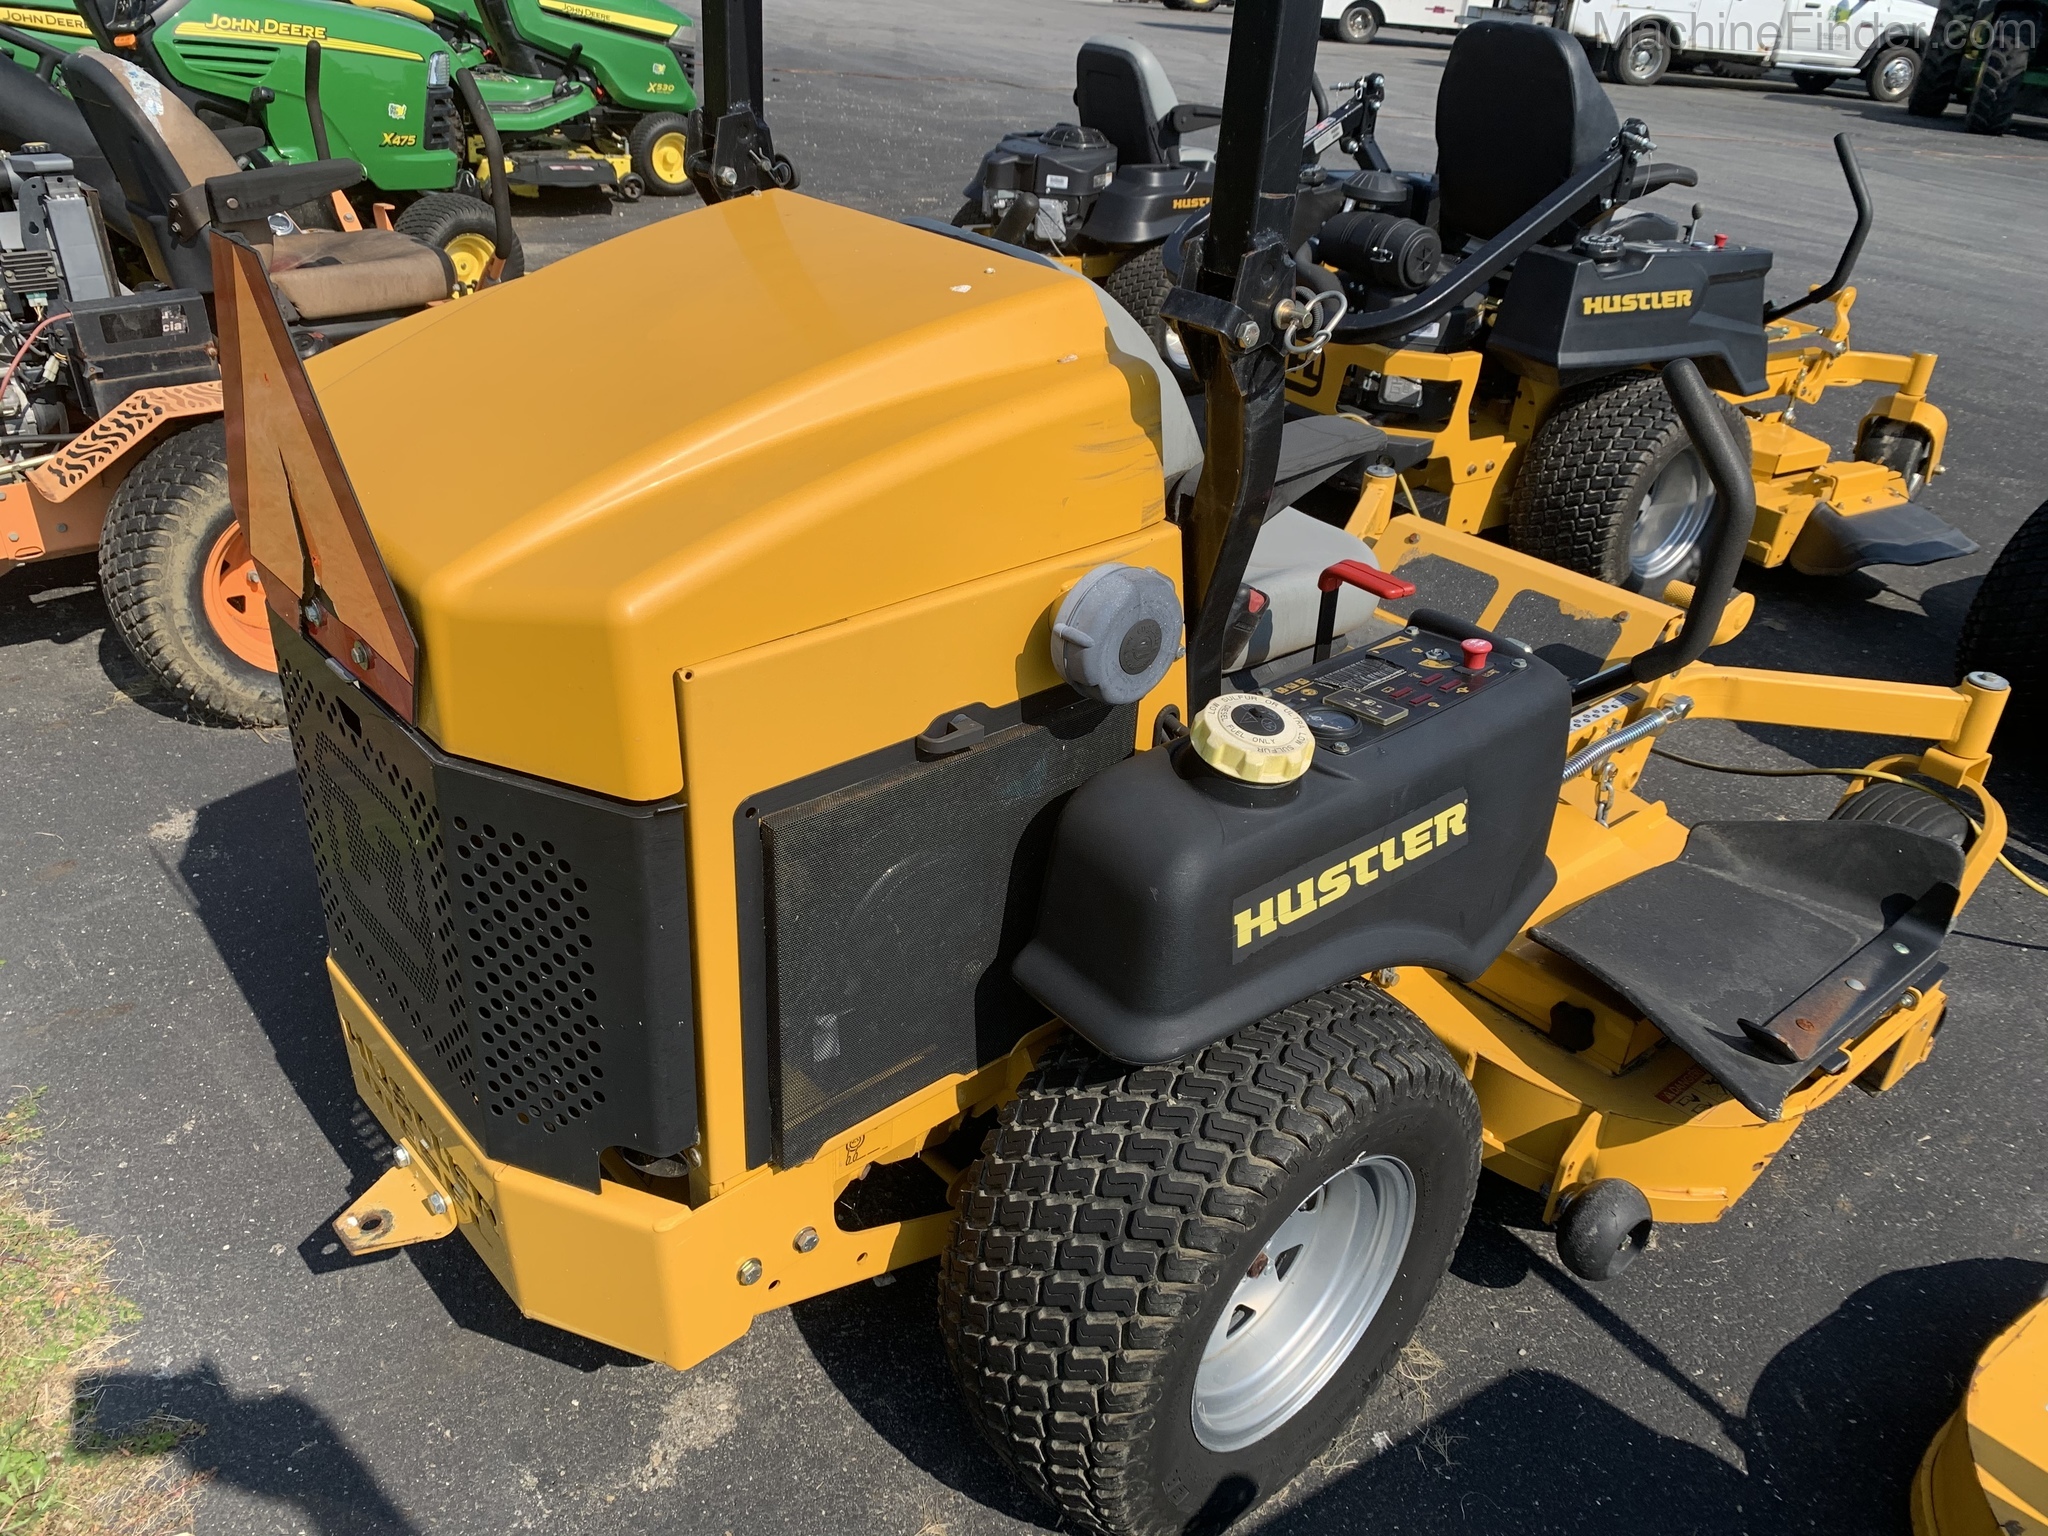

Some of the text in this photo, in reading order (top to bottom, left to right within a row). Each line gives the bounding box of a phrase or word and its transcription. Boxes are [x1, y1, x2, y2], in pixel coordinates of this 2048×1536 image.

[2, 9, 89, 29] JOHN DEER
[562, 3, 611, 20] JOHN DEERE
[205, 13, 327, 39] JOHN DEERE
[646, 82, 675, 93] X530
[381, 132, 417, 147] X475
[1172, 196, 1211, 209] HUST
[1582, 289, 1693, 315] HUSTLER
[1208, 702, 1219, 715] LOW
[1221, 695, 1258, 703] SULFUR
[1264, 699, 1279, 708] OR
[1283, 708, 1305, 729] ULTRA
[1226, 724, 1245, 739] FUEL
[1252, 737, 1276, 745] ONLY
[1233, 802, 1468, 949] HUSTLER
